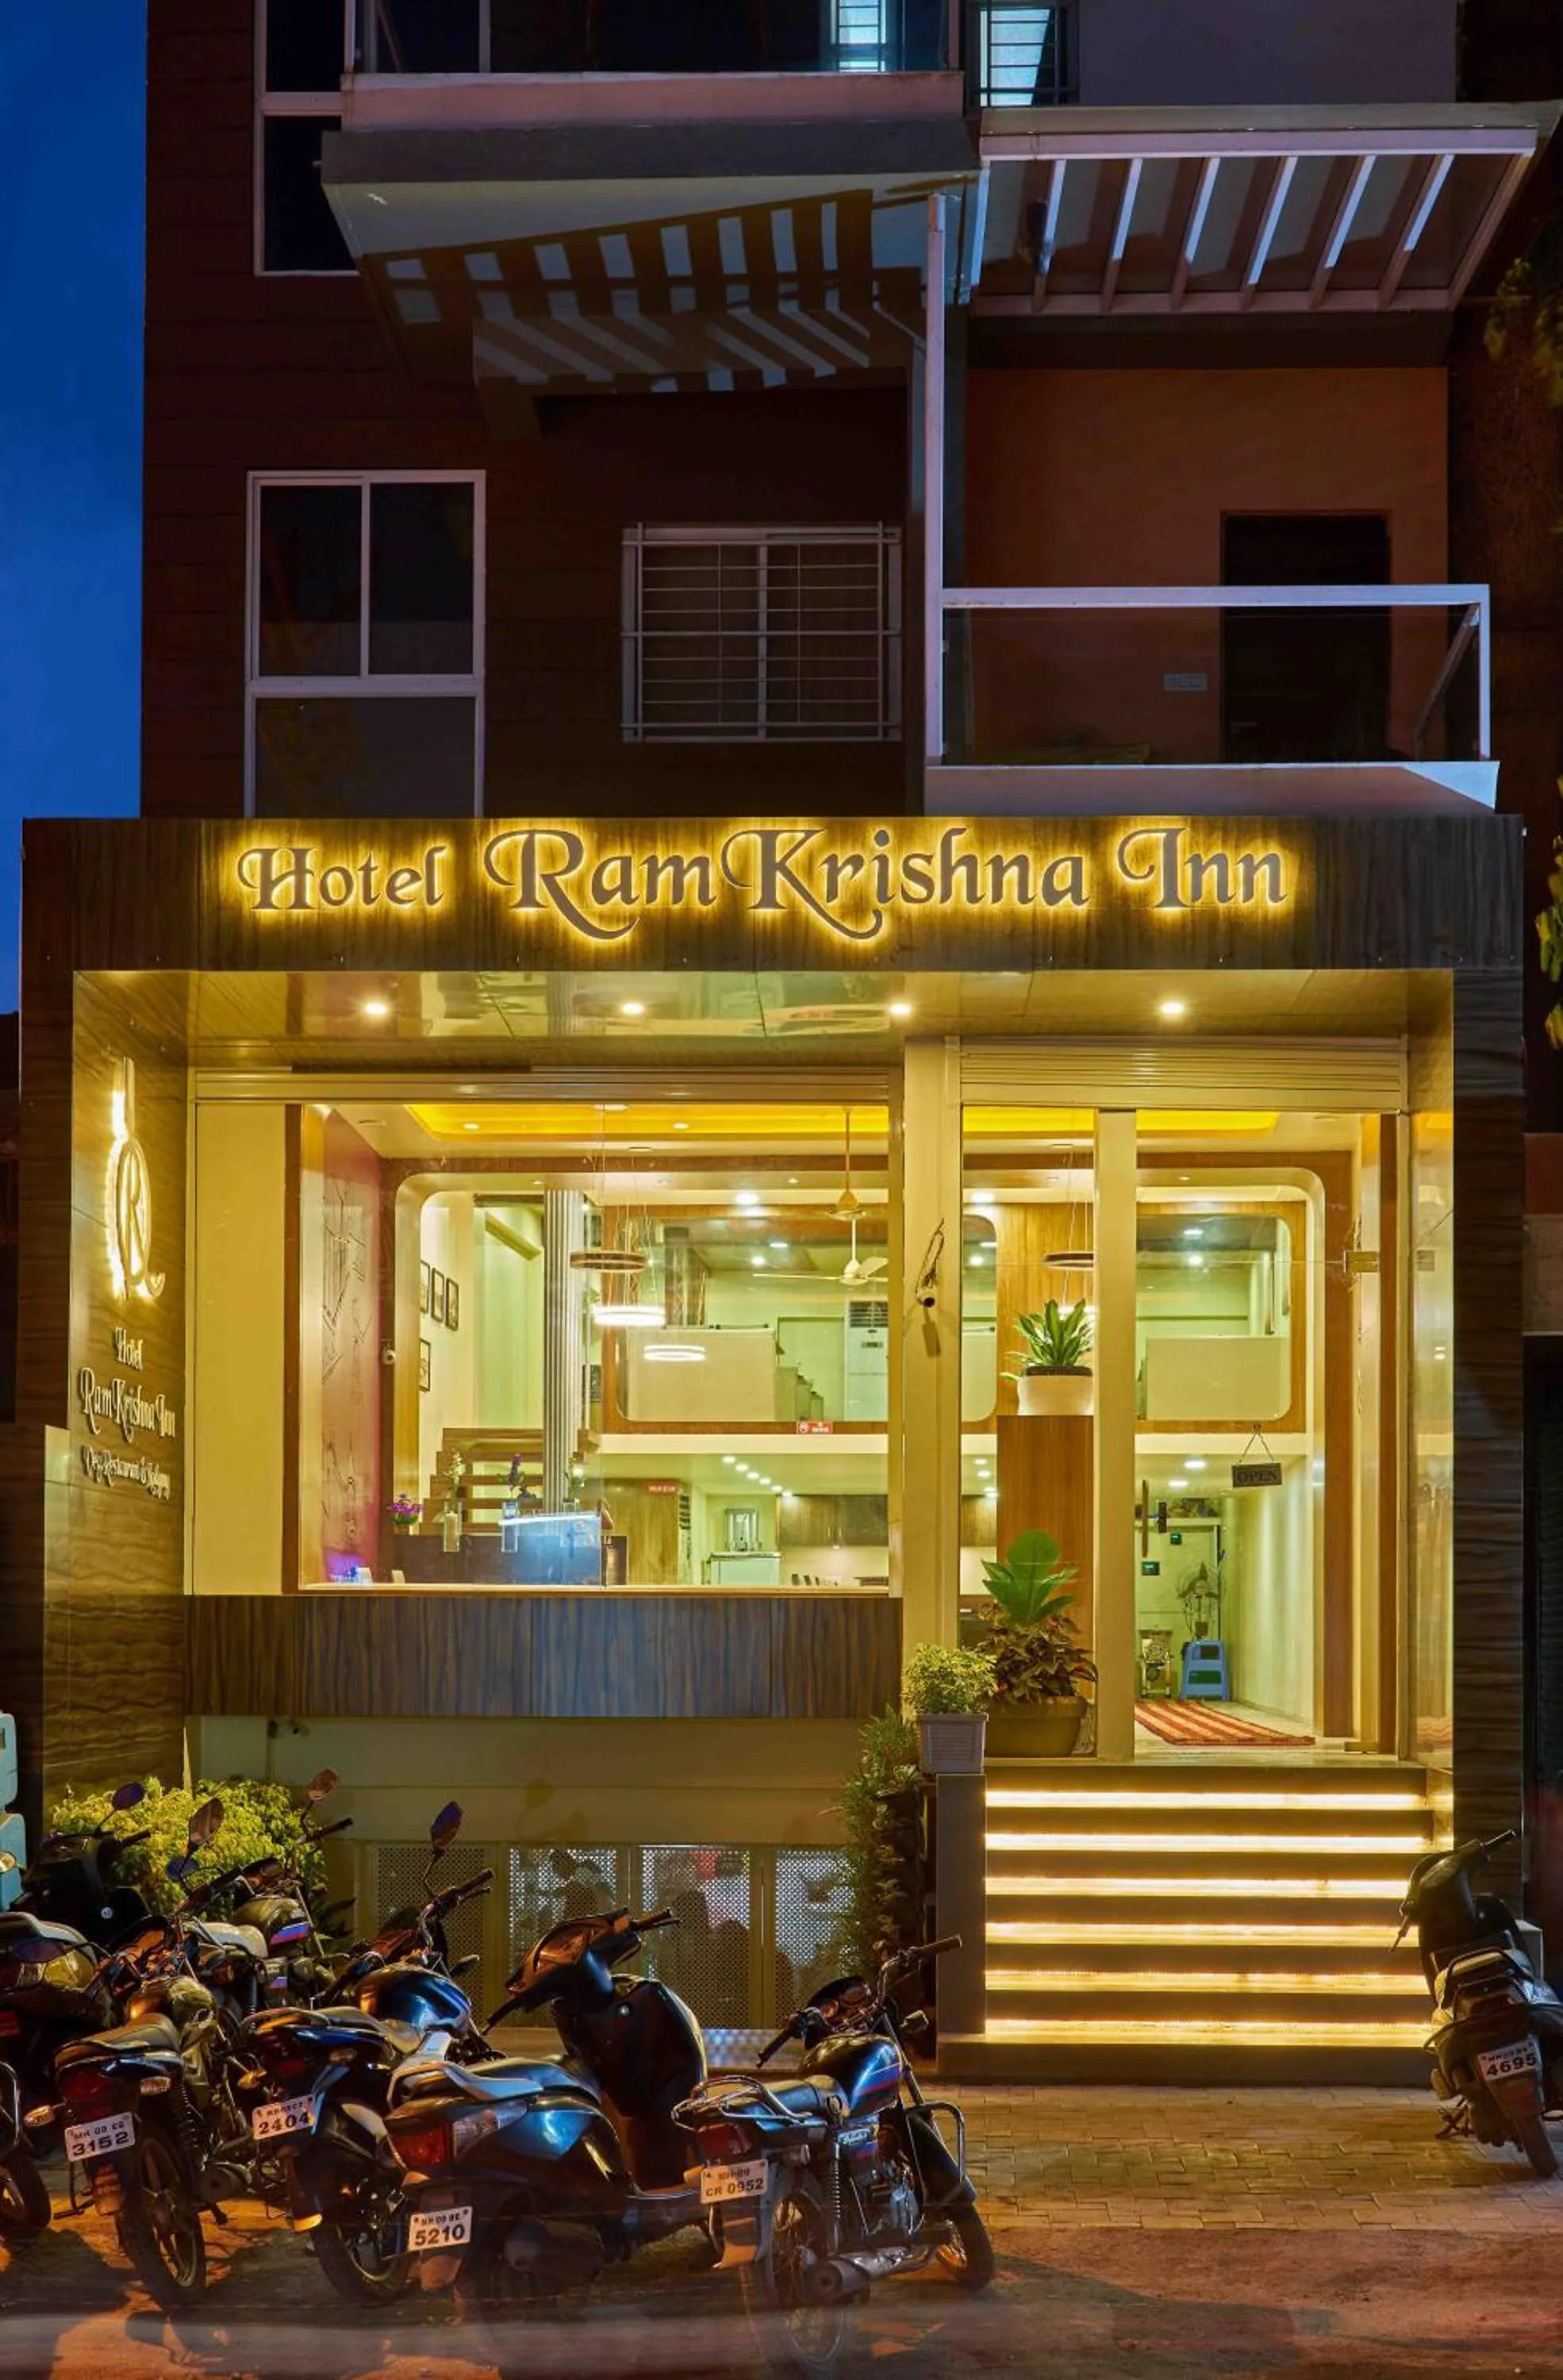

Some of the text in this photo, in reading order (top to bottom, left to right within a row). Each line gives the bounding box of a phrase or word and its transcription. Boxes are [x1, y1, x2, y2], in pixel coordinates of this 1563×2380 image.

[237, 845, 448, 911] Hotel
[1117, 827, 1288, 910] Inn
[114, 1326, 143, 1371] Hotel
[1238, 1468, 1277, 1484] OPEN
[1486, 2052, 1536, 2076] 4695
[259, 2110, 309, 2135] 2404
[72, 2131, 129, 2155] 3152
[728, 2178, 764, 2195] 0952
[414, 2224, 466, 2246] 5210
